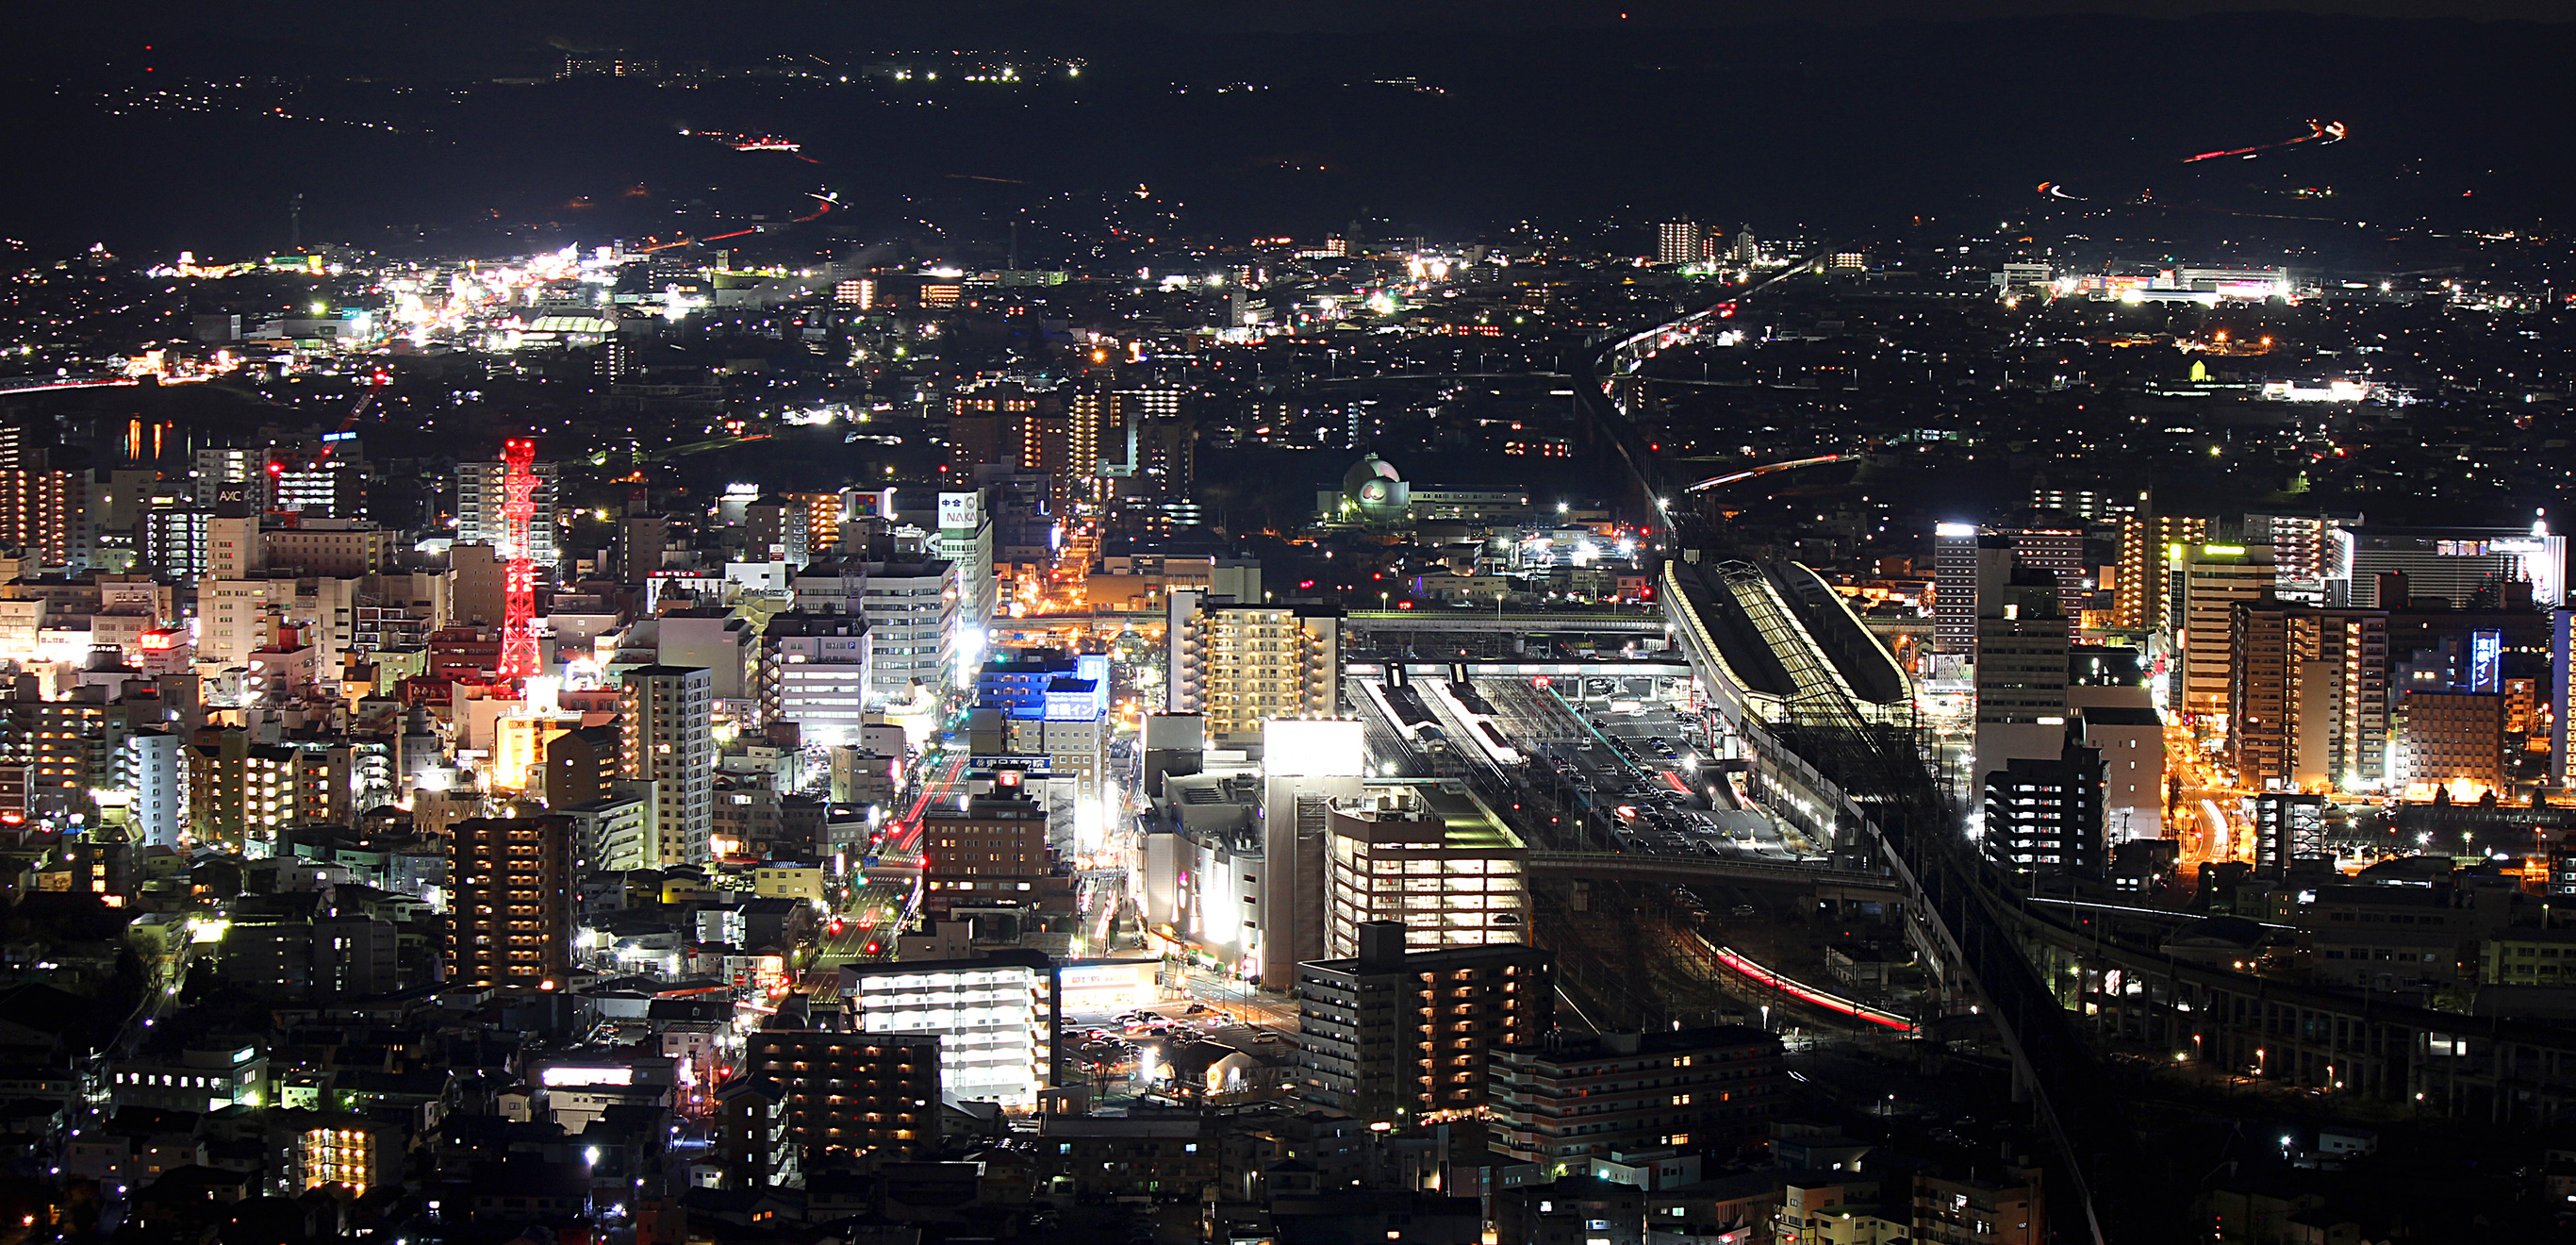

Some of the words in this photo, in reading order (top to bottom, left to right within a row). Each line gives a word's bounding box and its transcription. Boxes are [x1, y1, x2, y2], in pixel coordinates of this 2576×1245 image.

[219, 490, 241, 501] AXC
[1047, 703, 1093, 716] 東横イン
